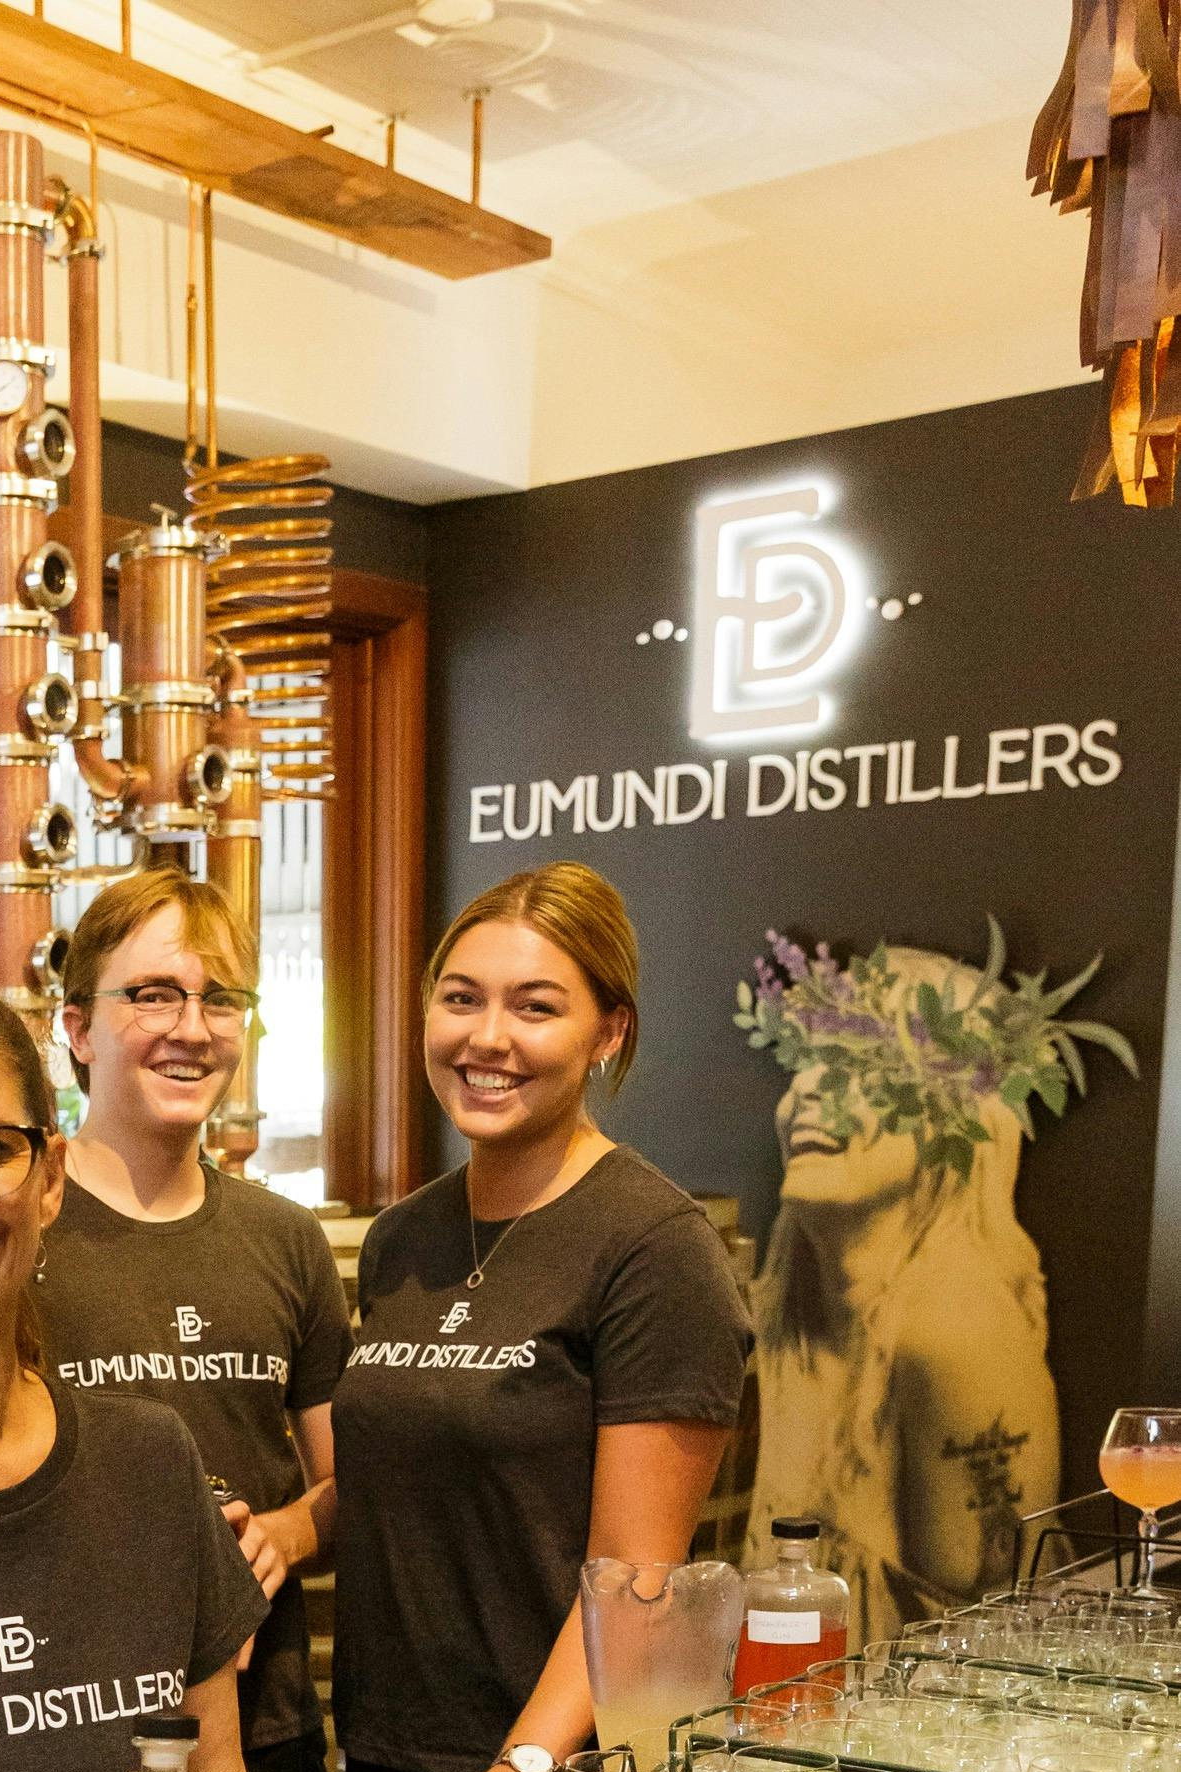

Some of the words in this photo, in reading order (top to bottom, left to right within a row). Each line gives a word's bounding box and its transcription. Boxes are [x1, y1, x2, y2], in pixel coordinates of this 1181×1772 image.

[468, 757, 729, 844] EUMUNDI
[747, 718, 1123, 819] DISTILLERS
[57, 1351, 178, 1389] EUMUNDI
[179, 1351, 289, 1386] DISTILLERS
[346, 1341, 420, 1369] UMUNDI
[416, 1339, 537, 1370] DISTILLERS
[1, 1668, 185, 1735] DISTILLERS
